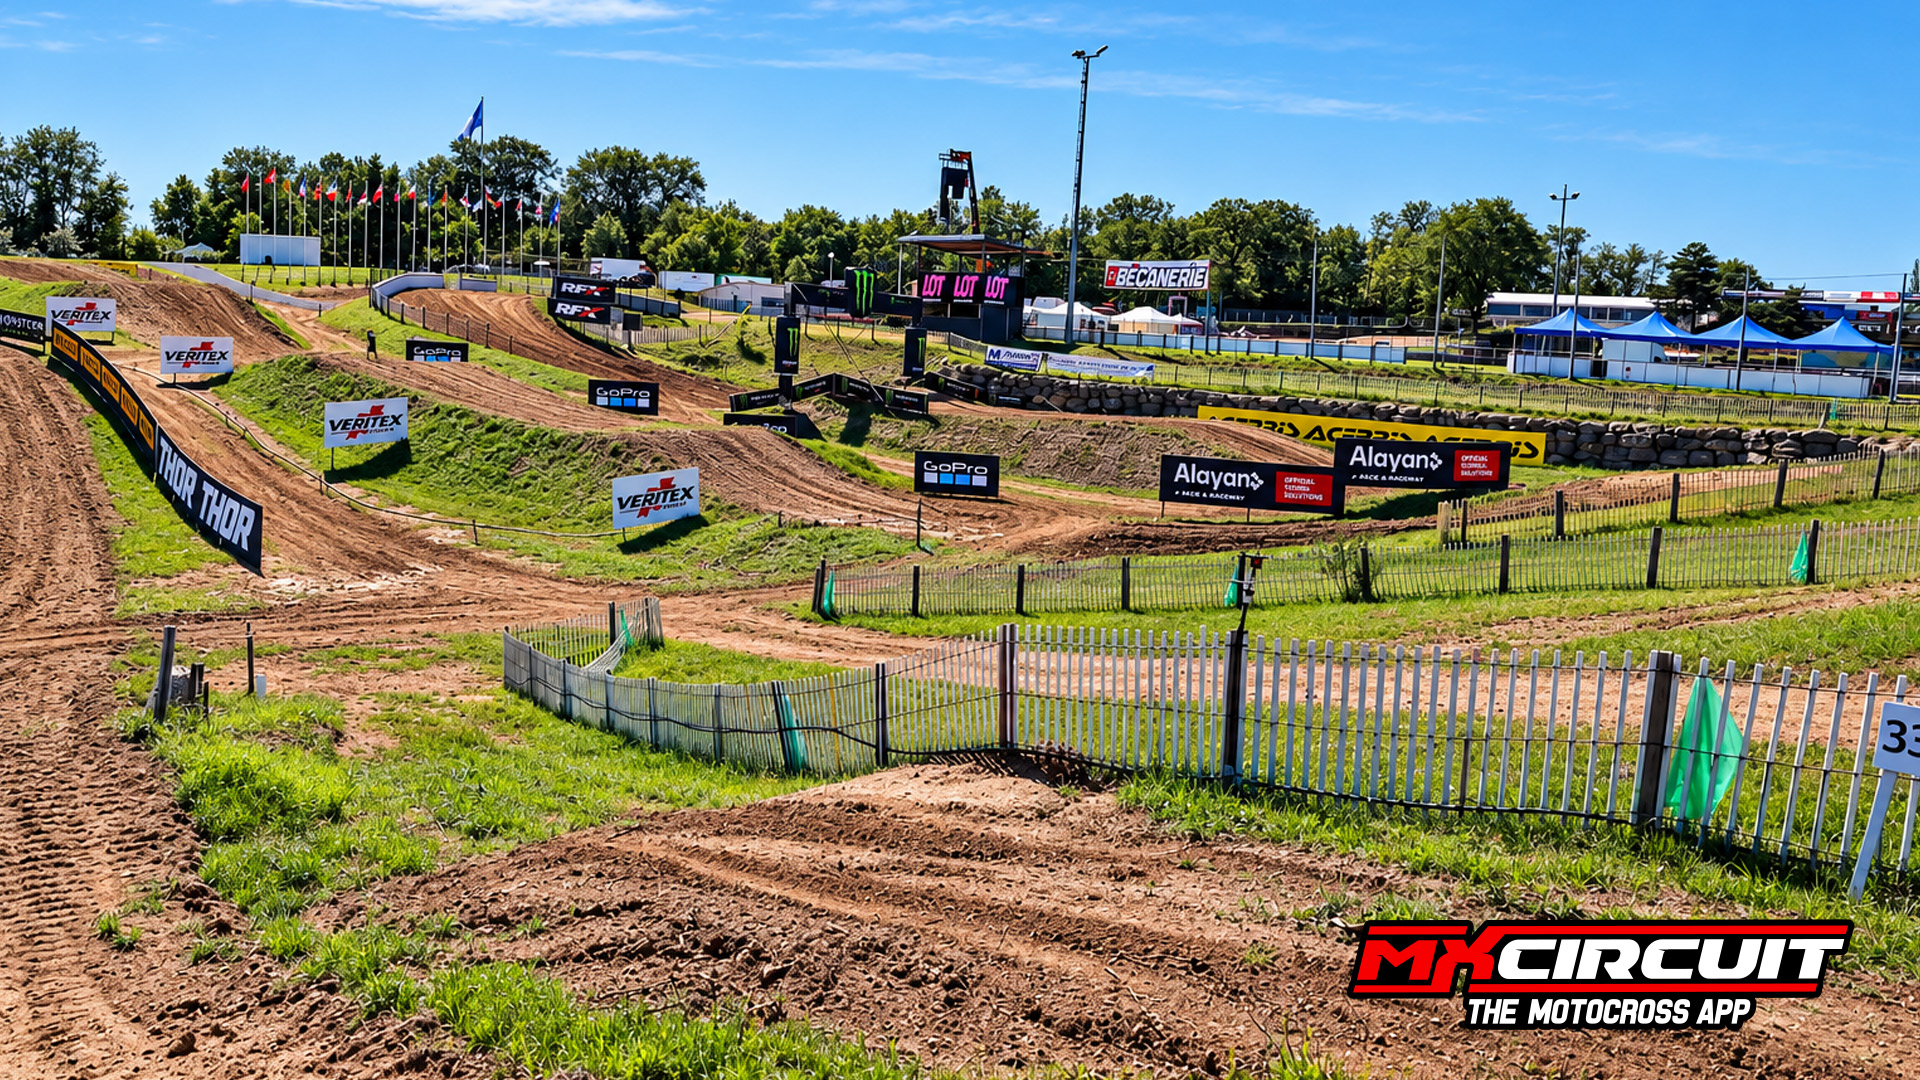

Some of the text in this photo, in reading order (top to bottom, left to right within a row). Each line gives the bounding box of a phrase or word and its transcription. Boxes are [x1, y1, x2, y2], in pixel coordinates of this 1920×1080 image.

[560, 282, 609, 296] RFX
[922, 274, 946, 297] LOT
[953, 275, 979, 297] LOT
[984, 275, 1009, 299] LOT
[51, 309, 112, 320] VERITEX
[555, 302, 605, 319] RFX
[165, 350, 229, 361] VERITEX
[596, 387, 650, 398] GoPro
[329, 413, 403, 431] VERITEX
[923, 460, 988, 474] GoPro
[1349, 445, 1429, 473] Alayan
[1173, 462, 1250, 491] Alayan
[158, 435, 256, 551] THOR THOR
[617, 485, 695, 510] VERITEX
